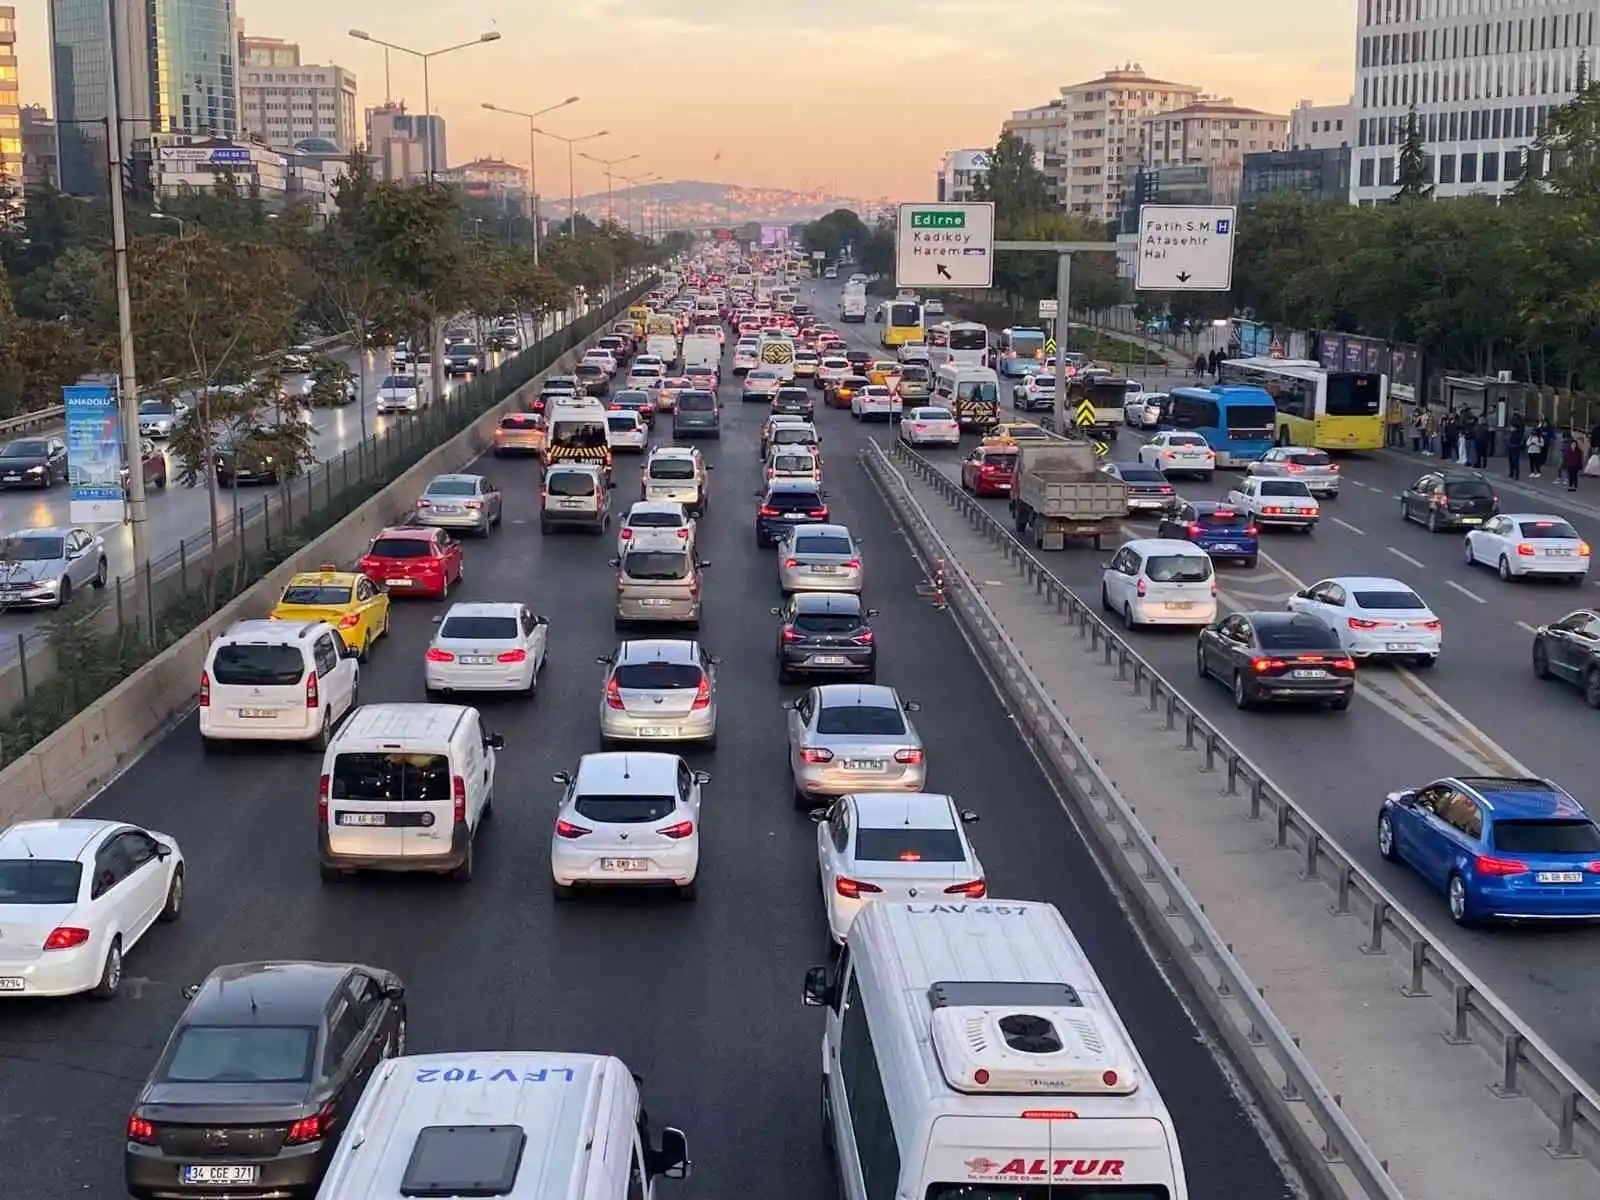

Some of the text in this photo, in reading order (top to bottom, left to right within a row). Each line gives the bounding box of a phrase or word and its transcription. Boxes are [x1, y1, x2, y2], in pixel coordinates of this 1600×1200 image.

[914, 214, 962, 225] Edirne
[1147, 221, 1182, 231] Fatih
[914, 246, 960, 256] Harem
[1144, 249, 1166, 259] Hal
[907, 904, 1027, 916] LAV 457
[416, 1068, 574, 1083] LFV 102
[997, 1158, 1125, 1175] ALTUR
[192, 1167, 252, 1179] 34 CGE 371
